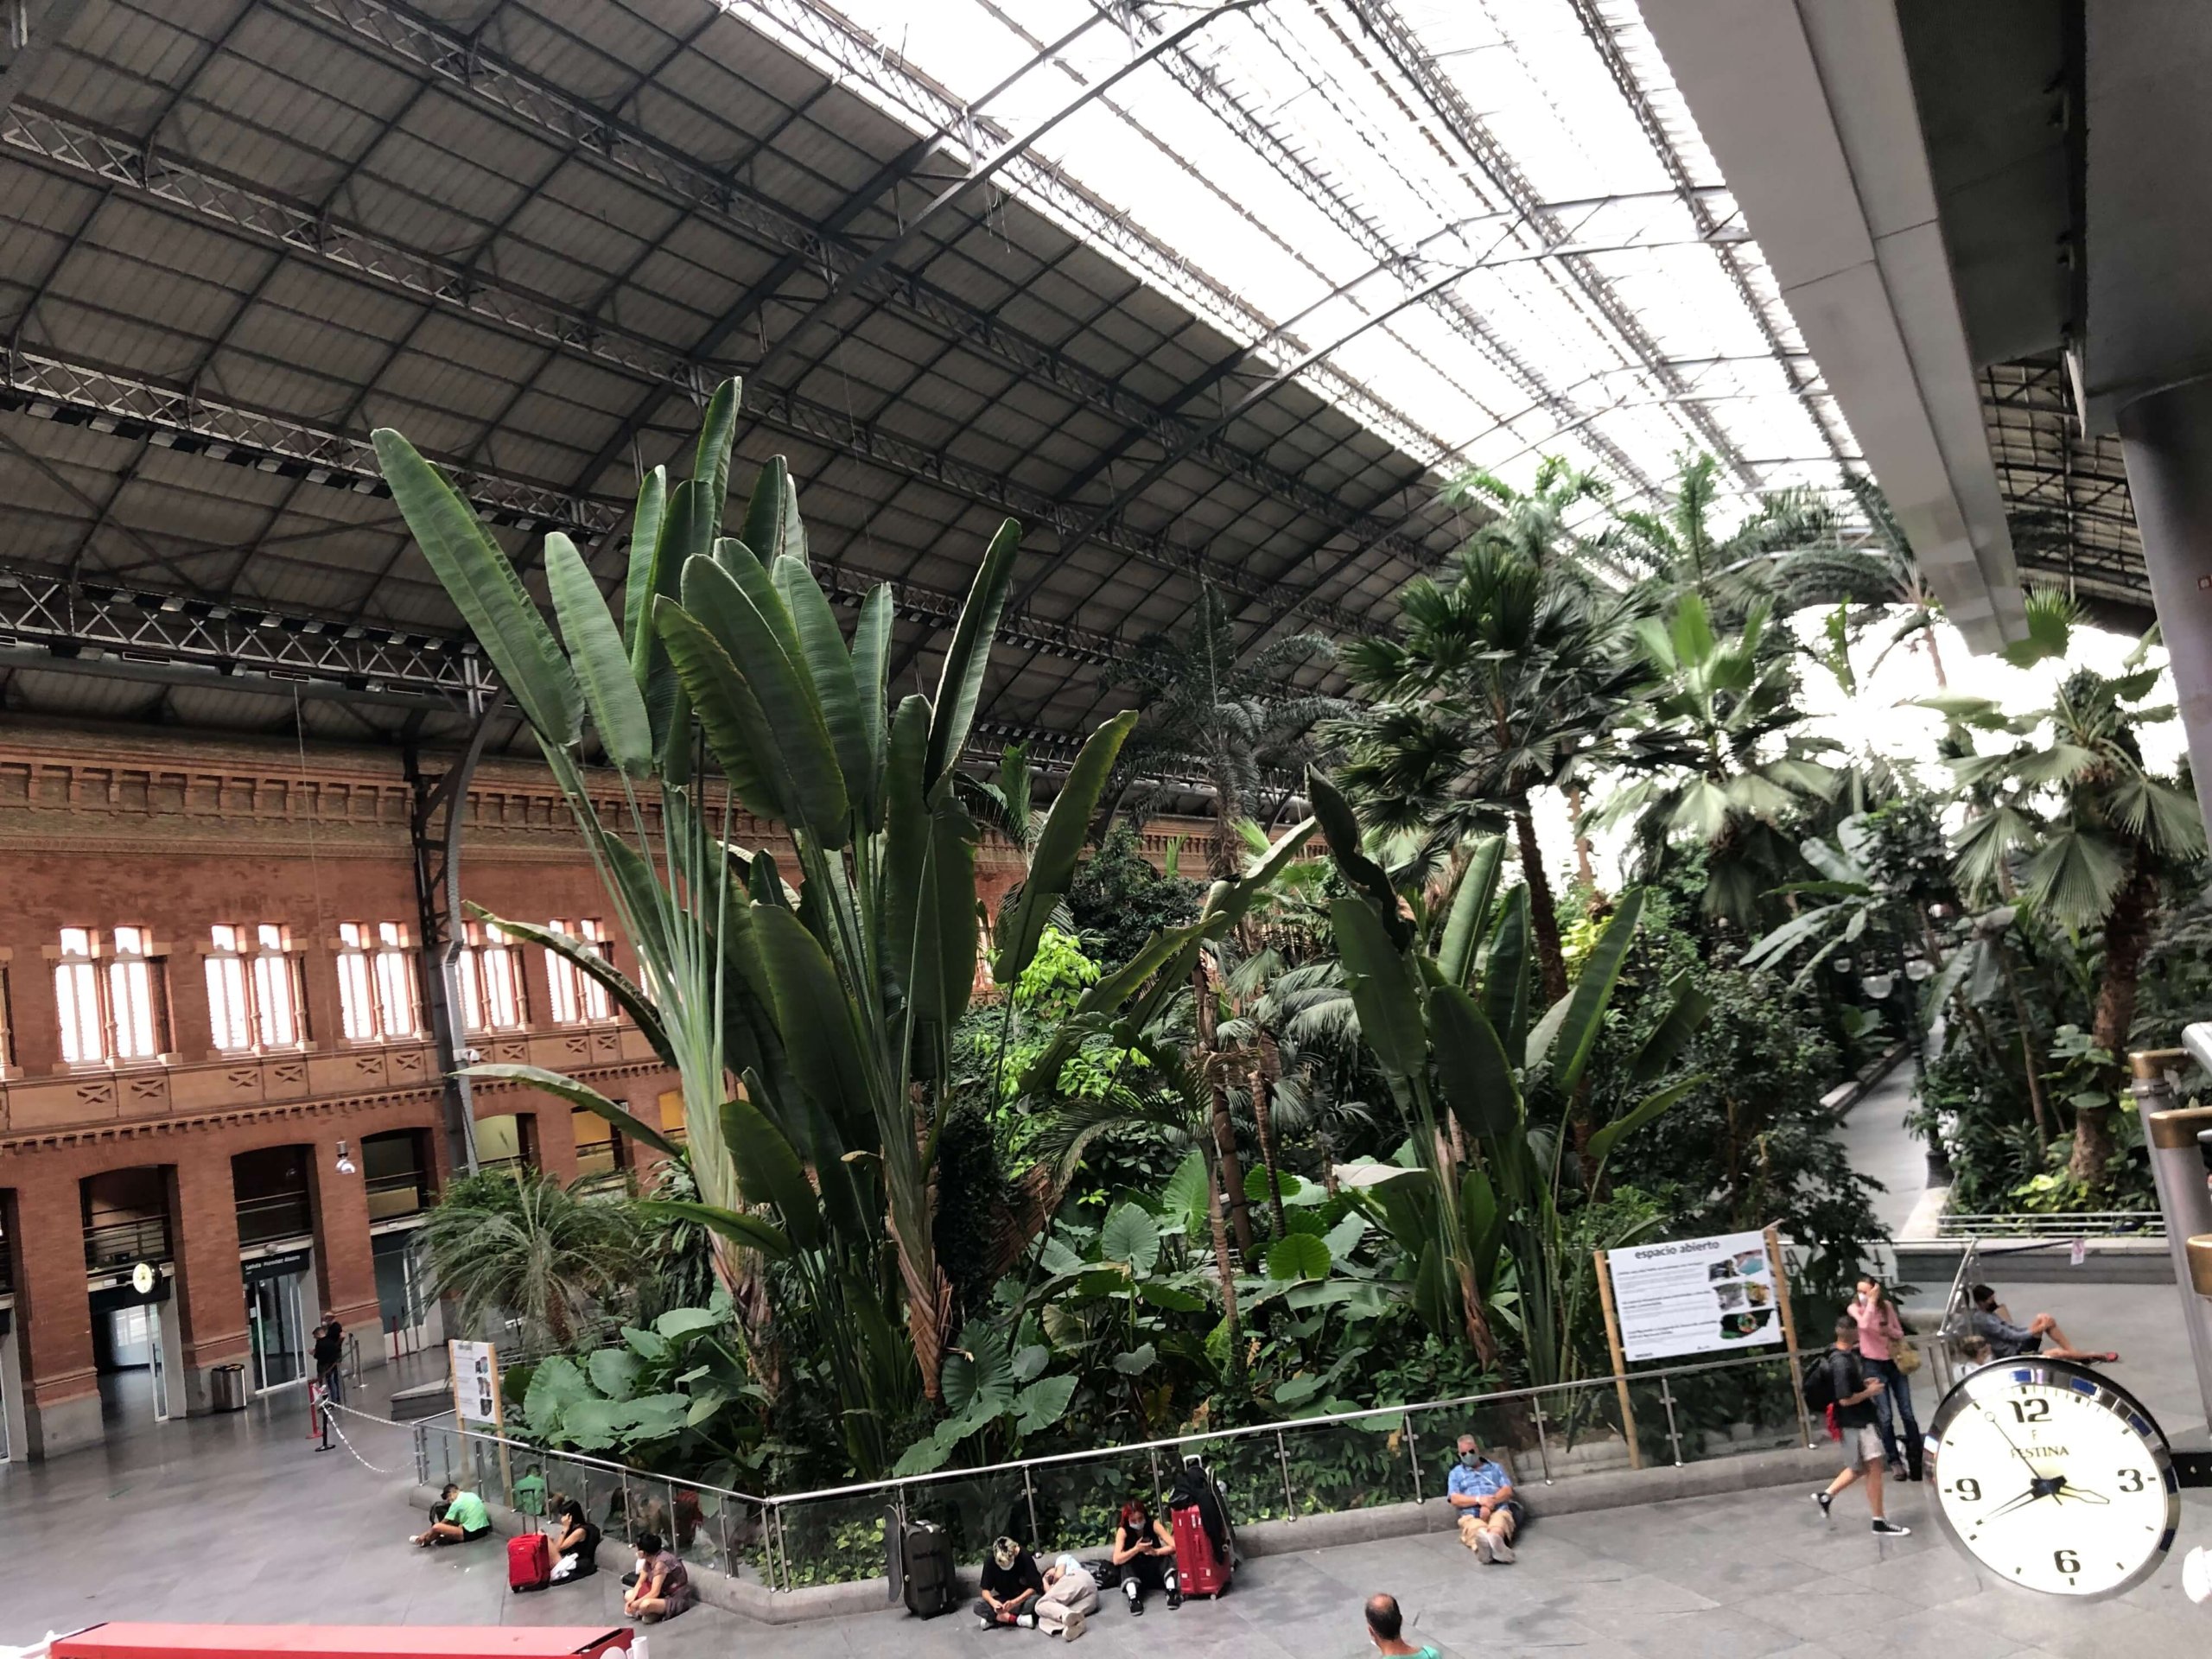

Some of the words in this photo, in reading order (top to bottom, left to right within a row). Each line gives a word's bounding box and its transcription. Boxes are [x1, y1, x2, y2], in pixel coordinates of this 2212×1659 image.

[1635, 1245, 1676, 1259] espacio
[1680, 1241, 1719, 1253] abierto
[2006, 1398, 2052, 1423] 12
[1955, 1478, 1981, 1501] 9
[2117, 1469, 2144, 1492] 3
[2054, 1549, 2081, 1573] 6
